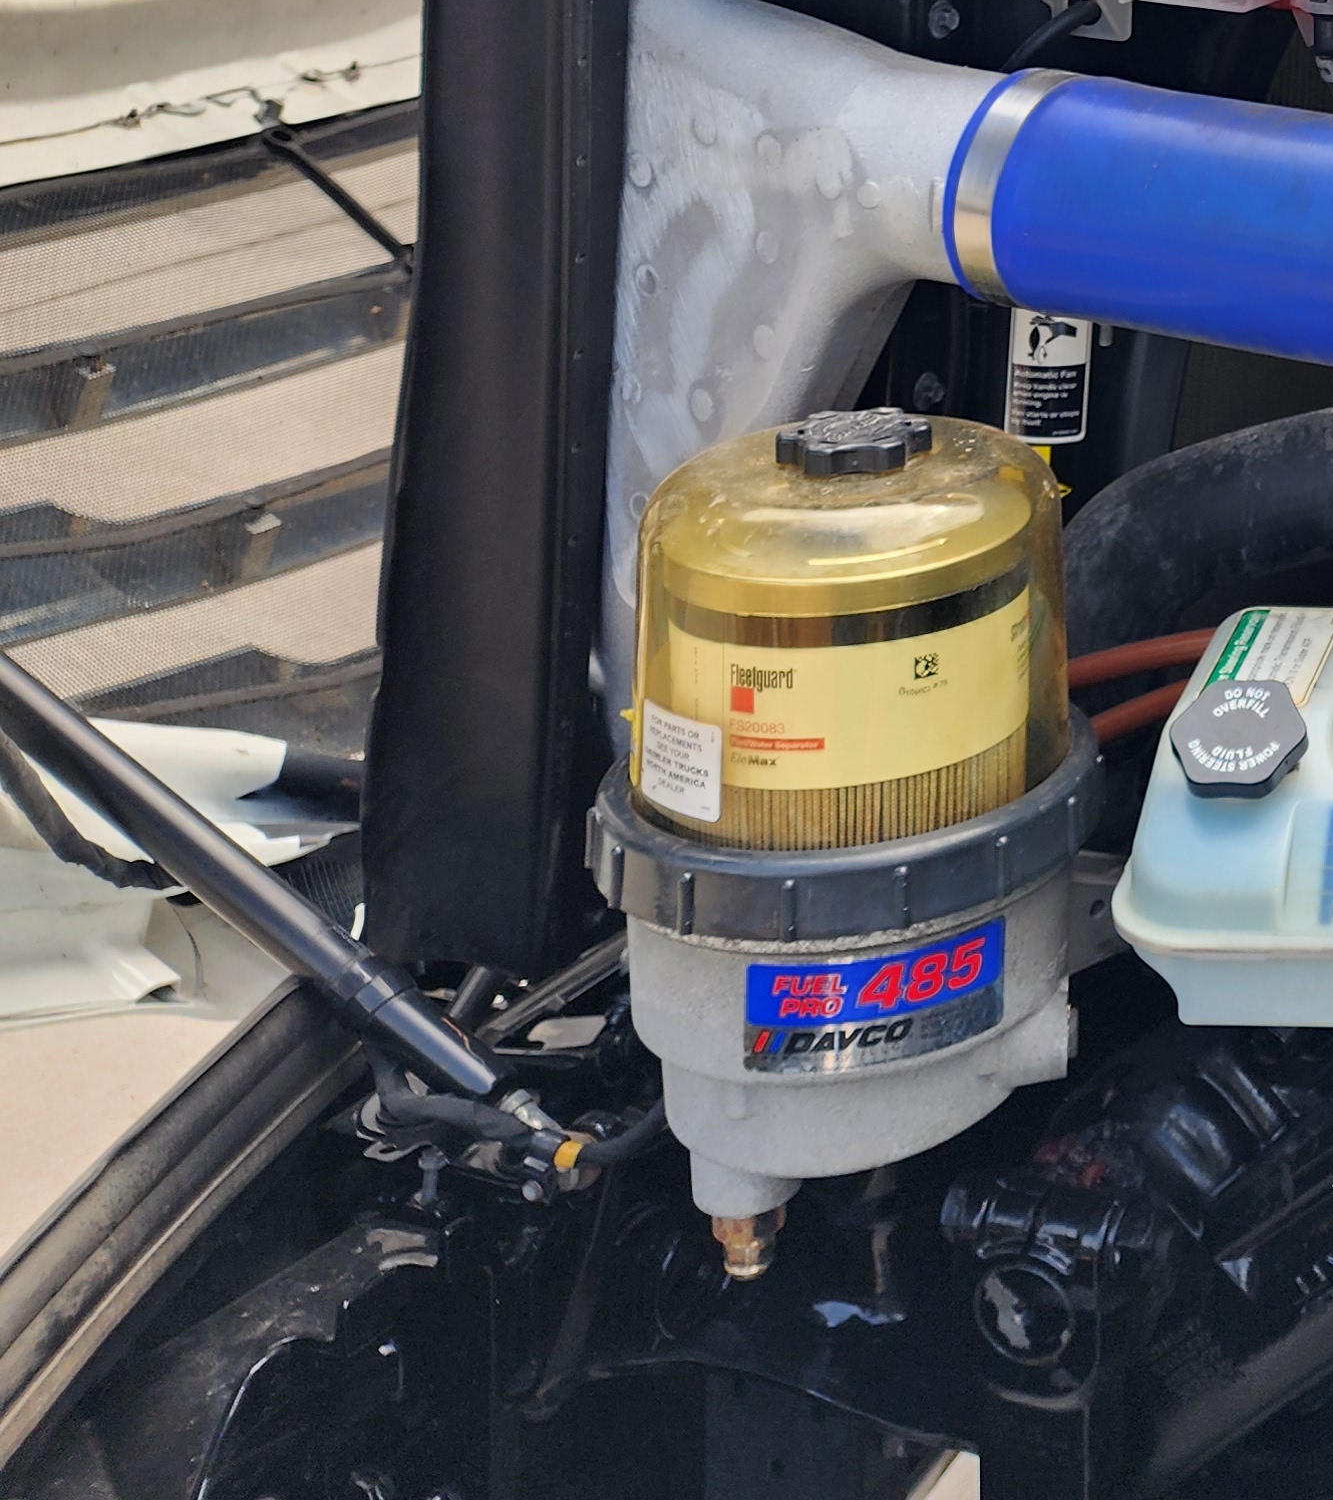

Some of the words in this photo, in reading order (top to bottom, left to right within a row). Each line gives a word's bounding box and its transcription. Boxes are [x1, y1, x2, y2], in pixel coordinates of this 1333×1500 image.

[1060, 369, 1078, 379] Fan
[730, 662, 794, 693] Fleetguard
[1223, 686, 1243, 701] DO
[1245, 686, 1272, 702] NOT
[1212, 697, 1271, 719] OVERFILL
[651, 714, 663, 726] FOR
[663, 721, 686, 737] PARTS
[687, 730, 700, 740] OR
[729, 718, 786, 735] FS20083
[649, 724, 703, 753] REPLACEMENTS
[773, 739, 820, 751] Separator
[669, 747, 690, 761] YOUR
[1188, 738, 1237, 773] STEERING
[1211, 744, 1254, 761] FLUID
[1238, 739, 1281, 771] POWER
[645, 759, 667, 777] NORTH
[668, 771, 707, 790] AMERICA
[674, 761, 709, 778] TRUCKS
[658, 777, 686, 794] DEALER
[771, 972, 849, 997] FUEL
[856, 936, 987, 1013] 485
[779, 996, 845, 1019] PRO
[784, 1018, 915, 1055] DAVCO
